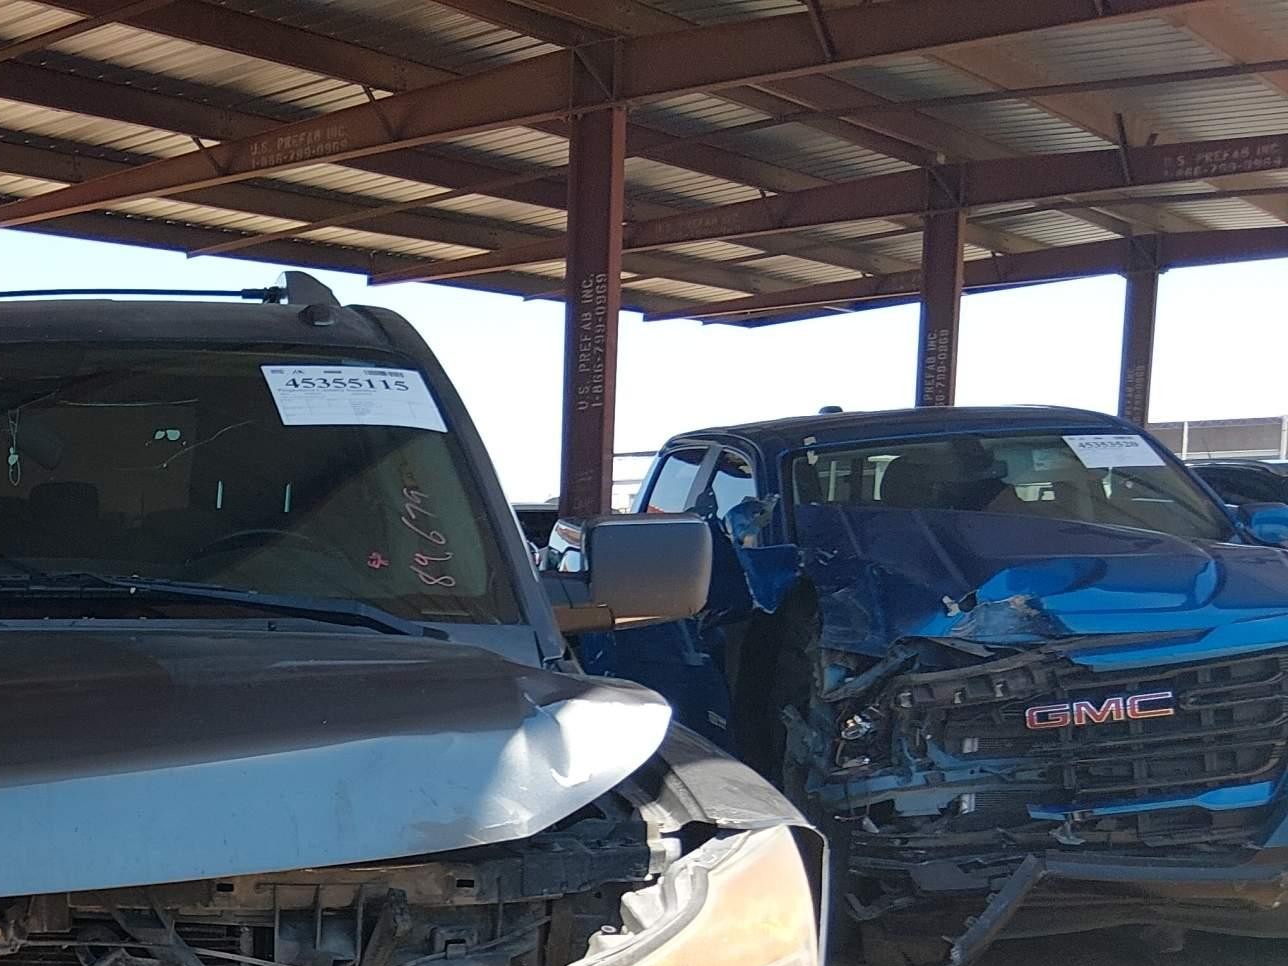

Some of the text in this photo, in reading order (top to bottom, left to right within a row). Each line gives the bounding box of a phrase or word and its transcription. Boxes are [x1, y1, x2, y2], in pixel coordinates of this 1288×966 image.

[577, 273, 594, 411] U.S. PREFAB INC.
[592, 273, 608, 407] 1-866-799-0969
[284, 377, 410, 392] 45355115
[922, 356, 937, 401] PREFAB
[1024, 690, 1175, 730] GMC
